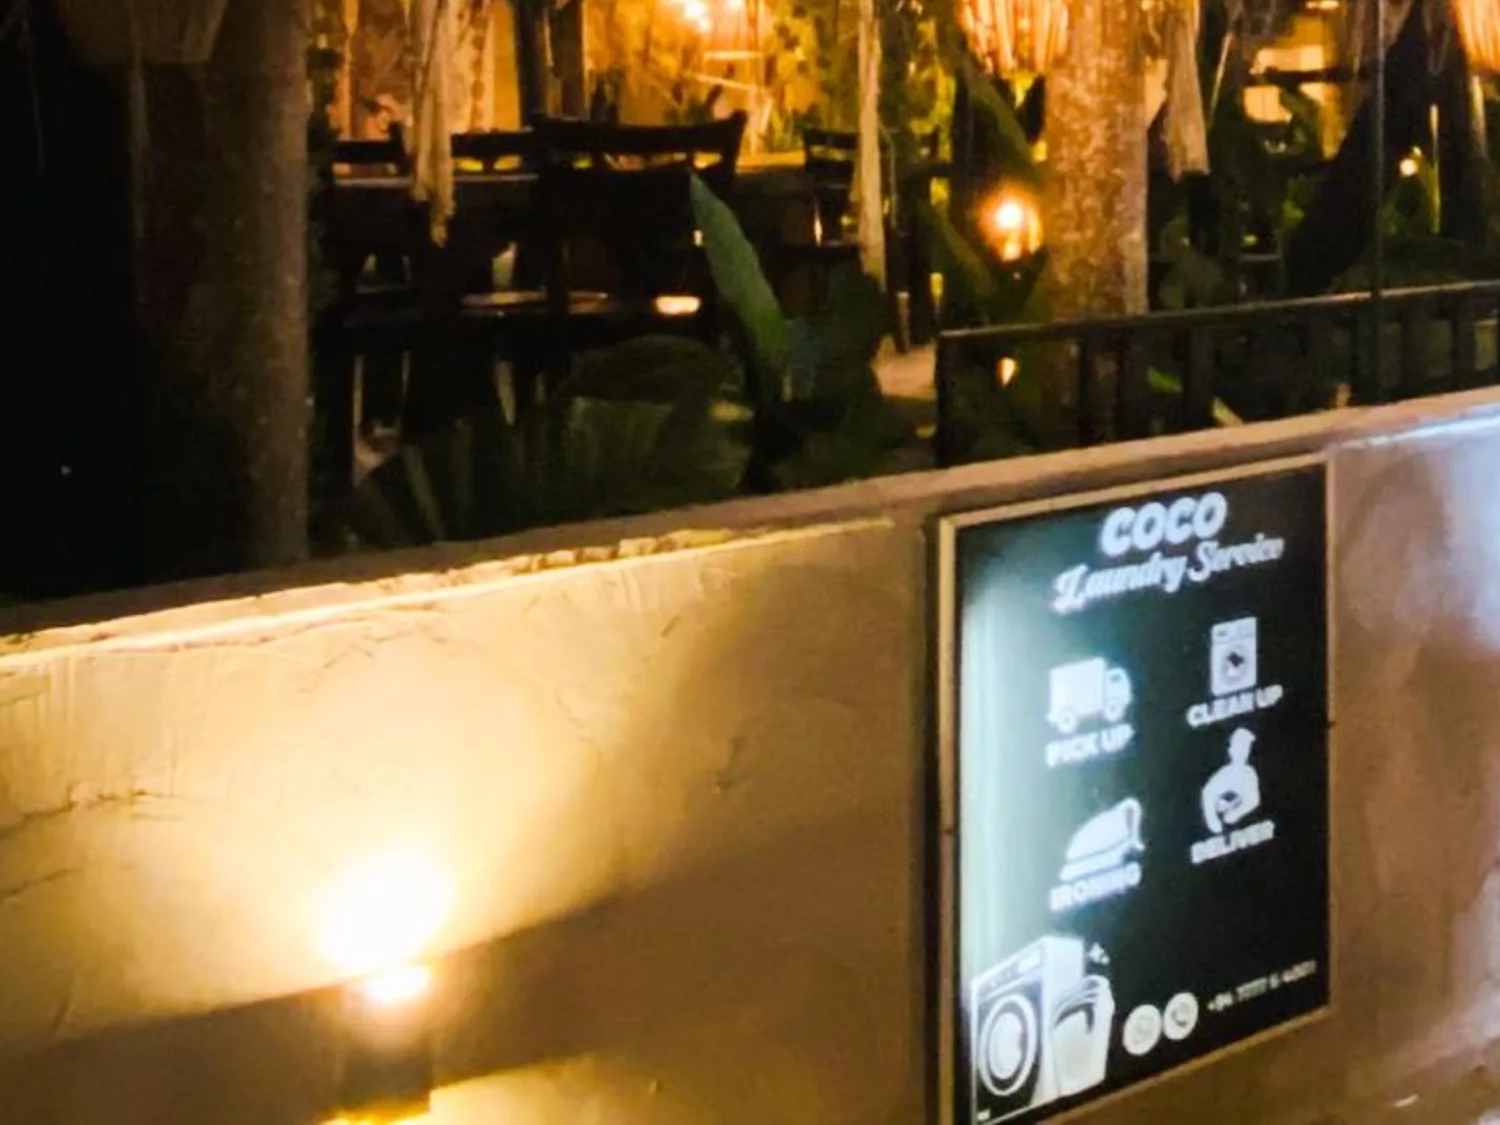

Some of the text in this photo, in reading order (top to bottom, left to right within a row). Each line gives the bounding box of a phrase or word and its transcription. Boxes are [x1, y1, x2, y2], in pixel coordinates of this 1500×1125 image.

[1099, 491, 1228, 556] COCO
[1050, 532, 1285, 615] Laundry Service
[1186, 683, 1284, 727] CLEAN UP
[1044, 723, 1135, 768] PICK UP
